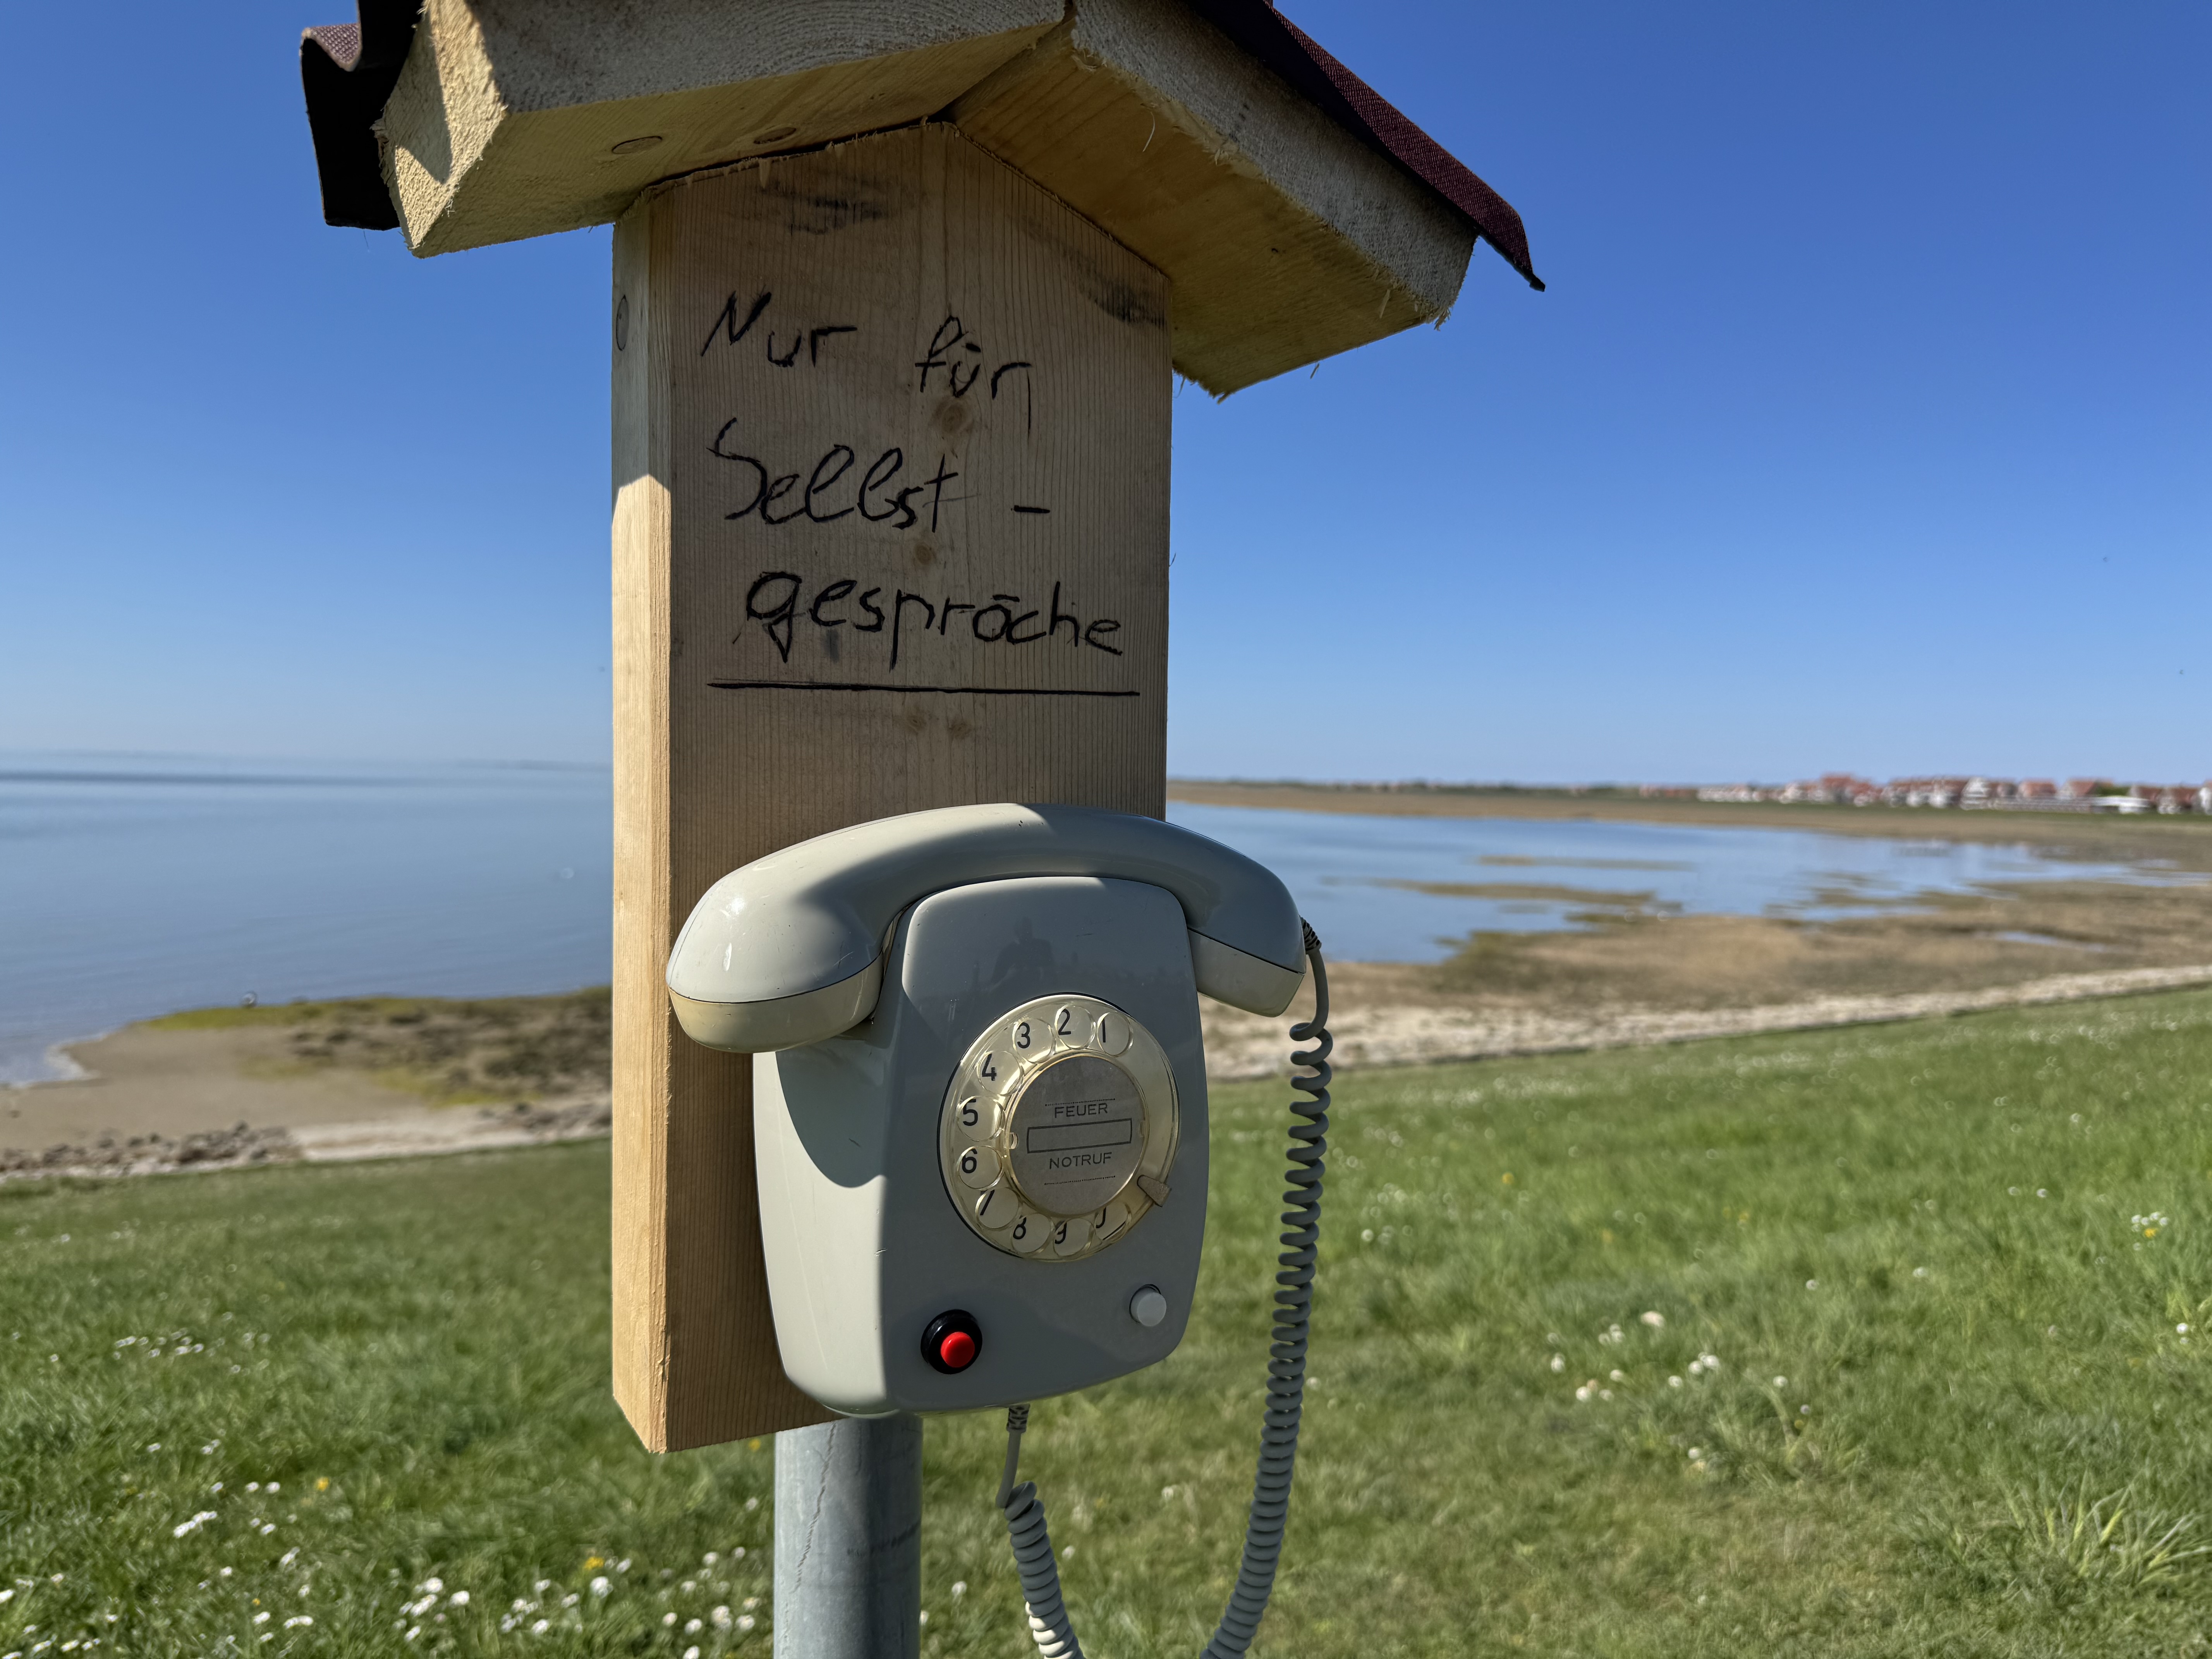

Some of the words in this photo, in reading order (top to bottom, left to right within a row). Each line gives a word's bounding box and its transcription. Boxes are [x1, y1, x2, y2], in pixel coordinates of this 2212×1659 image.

[700, 290, 857, 367] Nur
[707, 417, 958, 533] Selbst
[1017, 1022, 1031, 1049] 3
[1058, 1009, 1072, 1036] 2
[982, 1053, 997, 1081] 4
[962, 1099, 978, 1126] 5
[1054, 1103, 1108, 1118] FEUER
[961, 1148, 978, 1174] 6
[1049, 1152, 1112, 1169] NOTRUF
